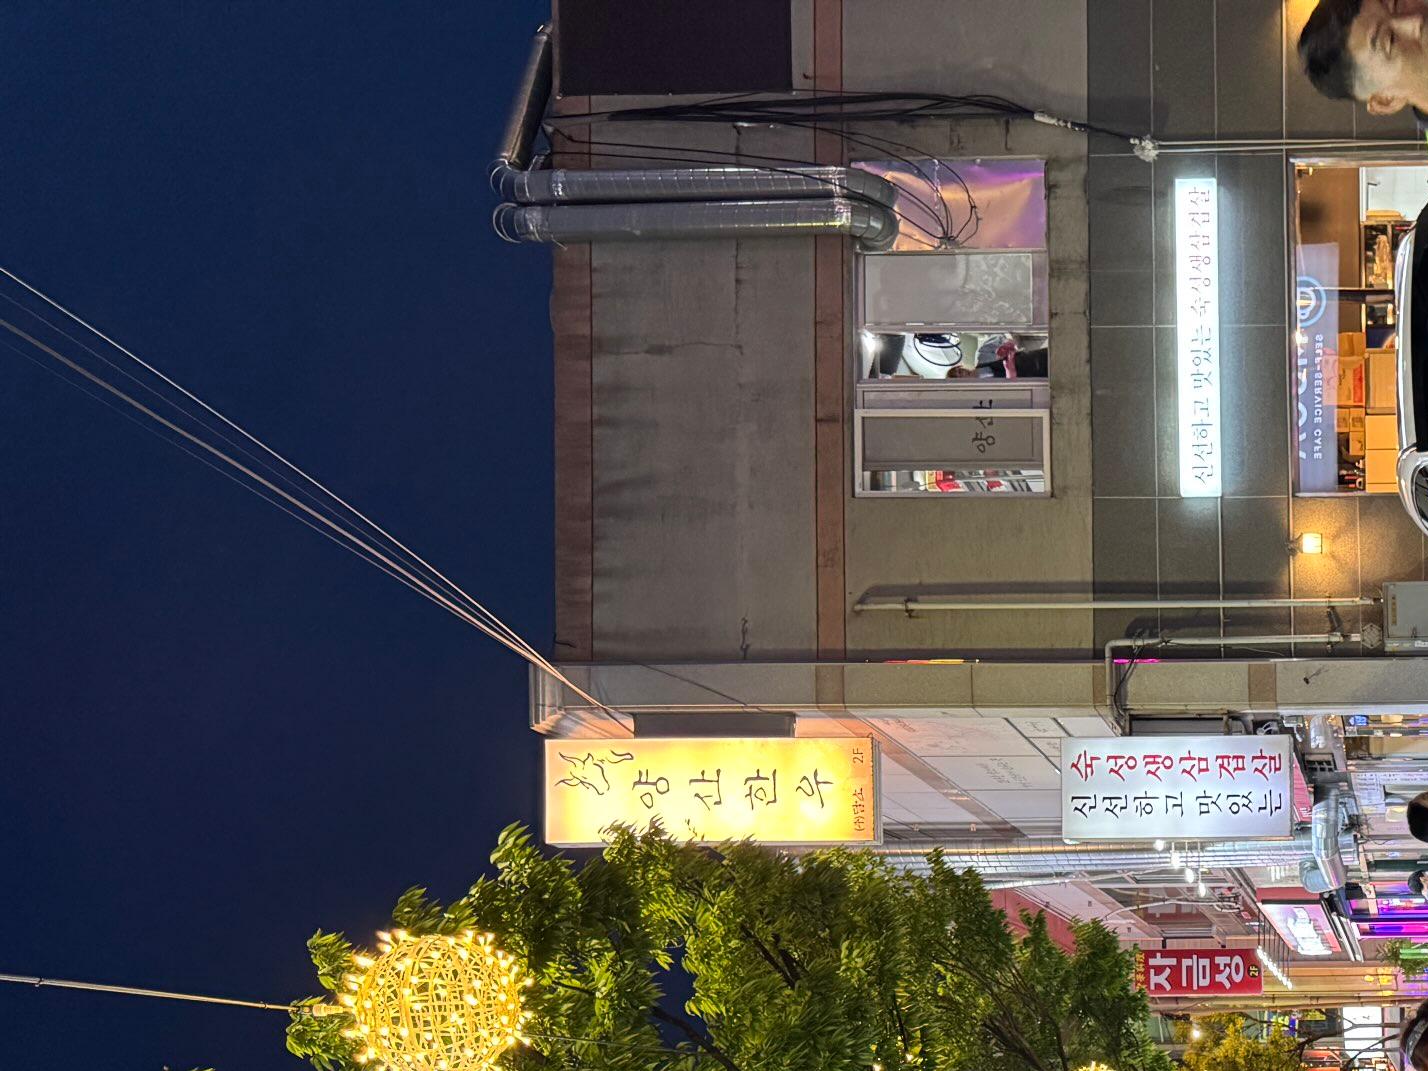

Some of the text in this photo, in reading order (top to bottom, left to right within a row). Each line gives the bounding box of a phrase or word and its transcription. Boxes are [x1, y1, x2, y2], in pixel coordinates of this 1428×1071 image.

[1189, 325, 1213, 390] 맛있는
[1190, 397, 1214, 485] 신선하고
[852, 748, 864, 764] 2F
[1070, 748, 1282, 782] 숙성생삼겹살
[632, 769, 834, 811] 양산한우
[1070, 790, 1282, 819] 신선하고 맛있는
[1148, 952, 1245, 991] 자금성
[1249, 965, 1259, 977] 2F
